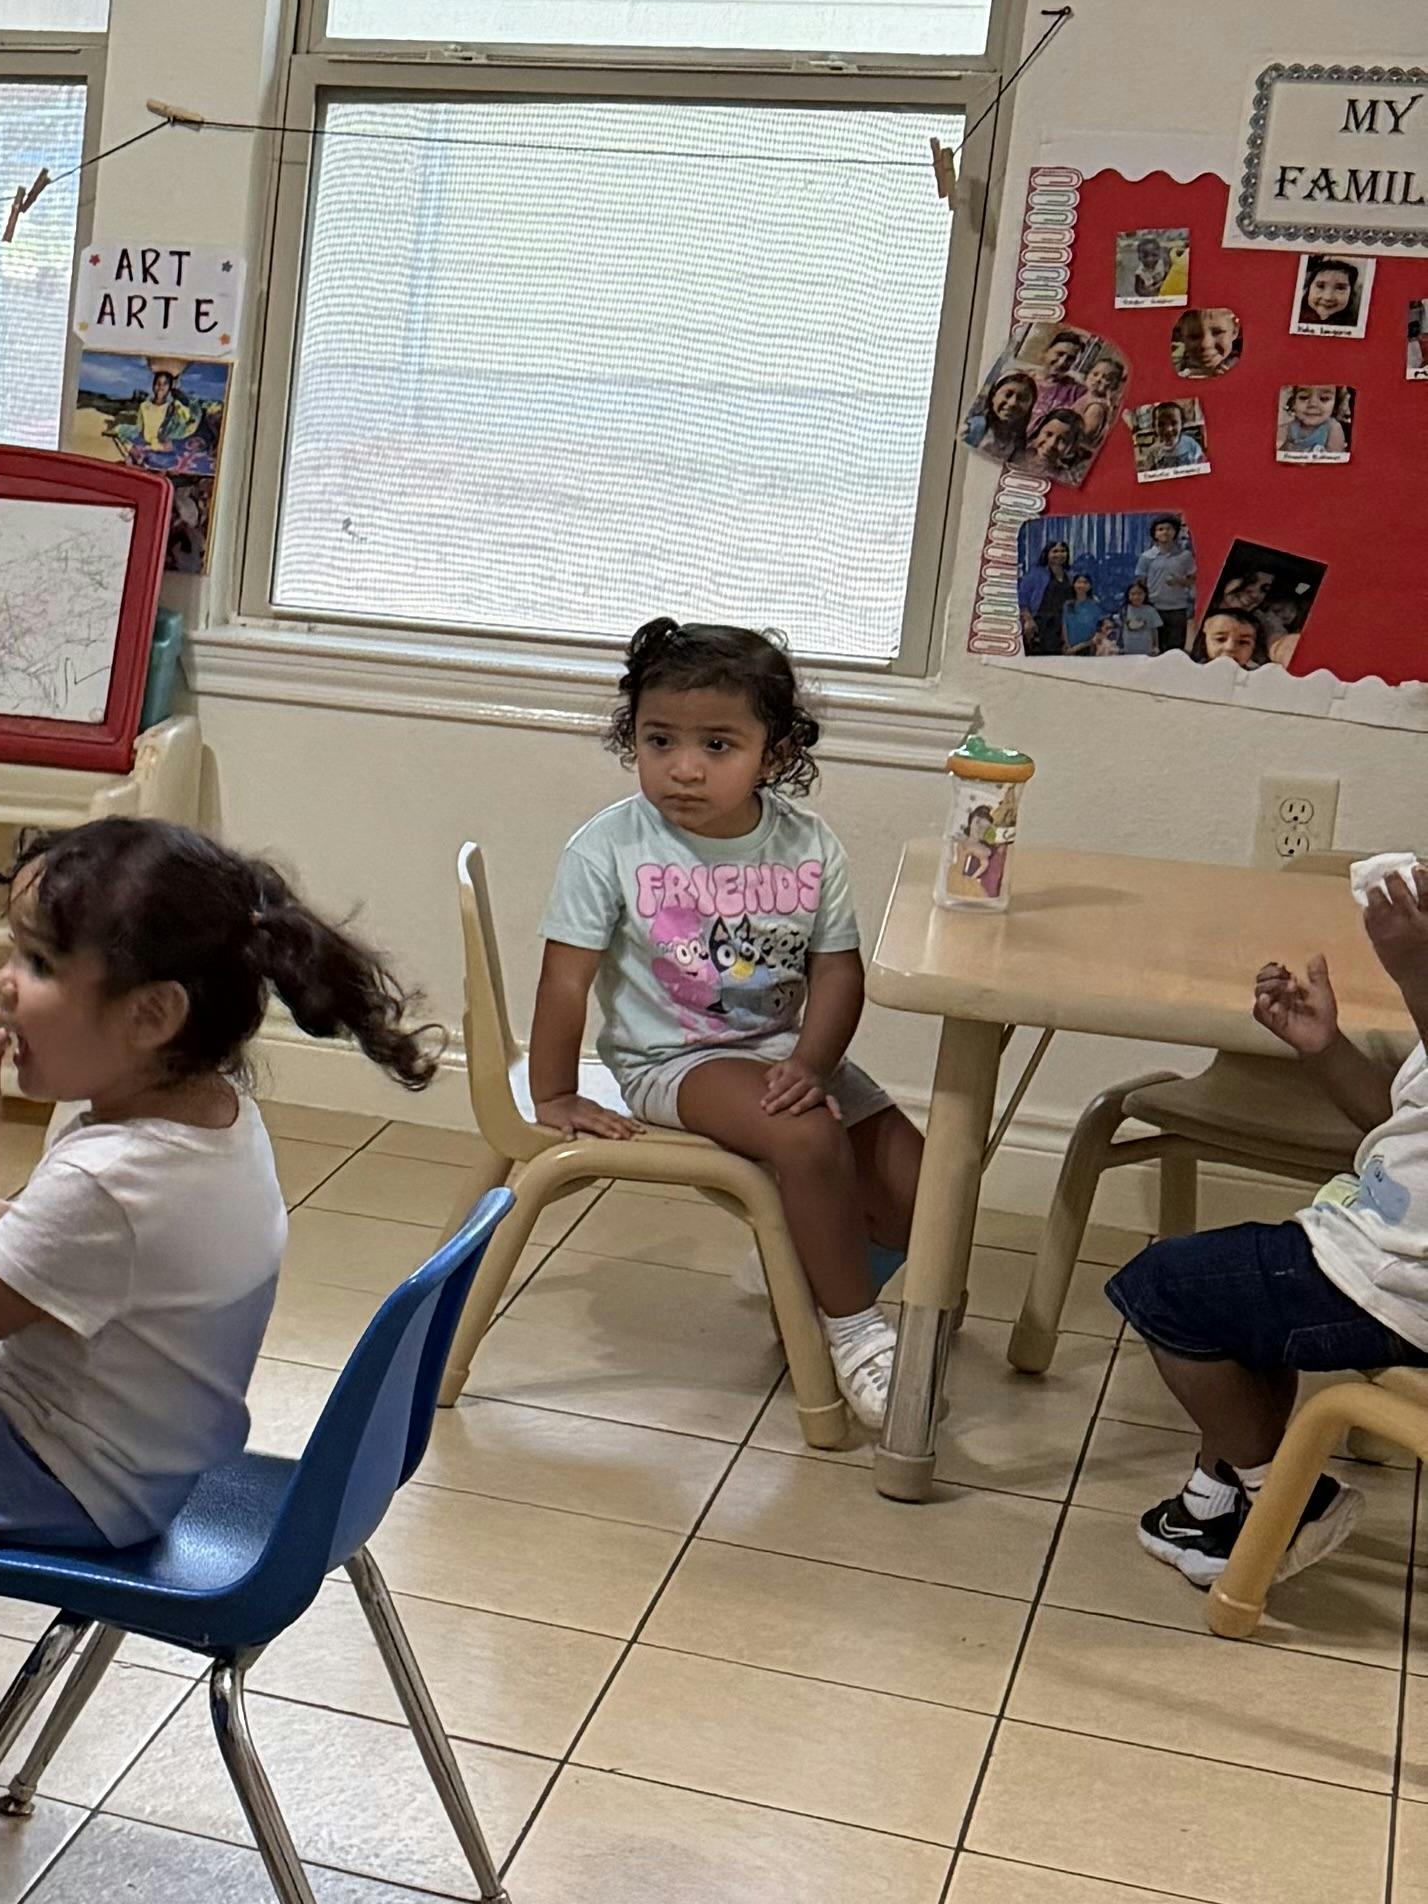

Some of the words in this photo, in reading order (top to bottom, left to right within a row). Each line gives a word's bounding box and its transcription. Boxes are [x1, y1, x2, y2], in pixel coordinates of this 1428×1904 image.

[1338, 93, 1425, 135] MY
[114, 247, 192, 287] ART
[96, 293, 219, 334] ARTE
[635, 859, 824, 919] FRIENDS
